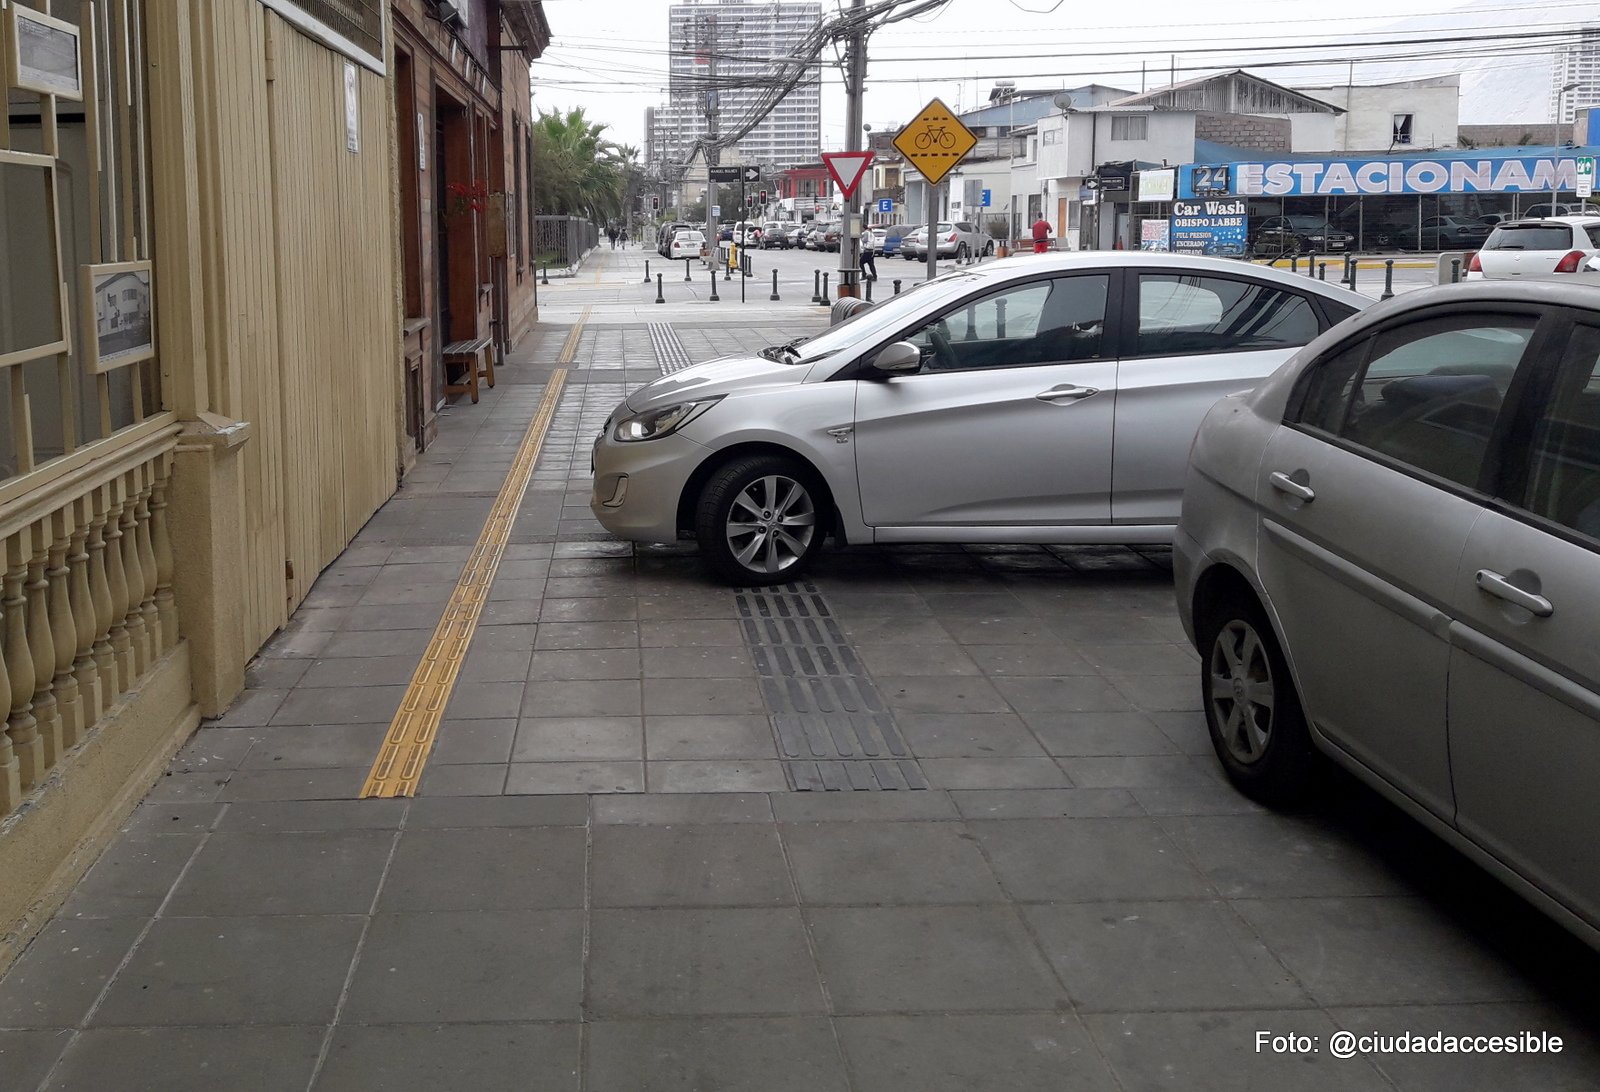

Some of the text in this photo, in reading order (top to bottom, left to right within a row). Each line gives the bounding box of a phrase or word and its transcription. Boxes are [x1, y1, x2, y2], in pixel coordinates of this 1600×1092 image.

[1196, 166, 1226, 187] 24
[1236, 159, 1597, 195] ESTACIONAM
[882, 201, 888, 210] E
[1173, 201, 1246, 216] Car Wash
[1174, 217, 1243, 227] OBISPO LABBE
